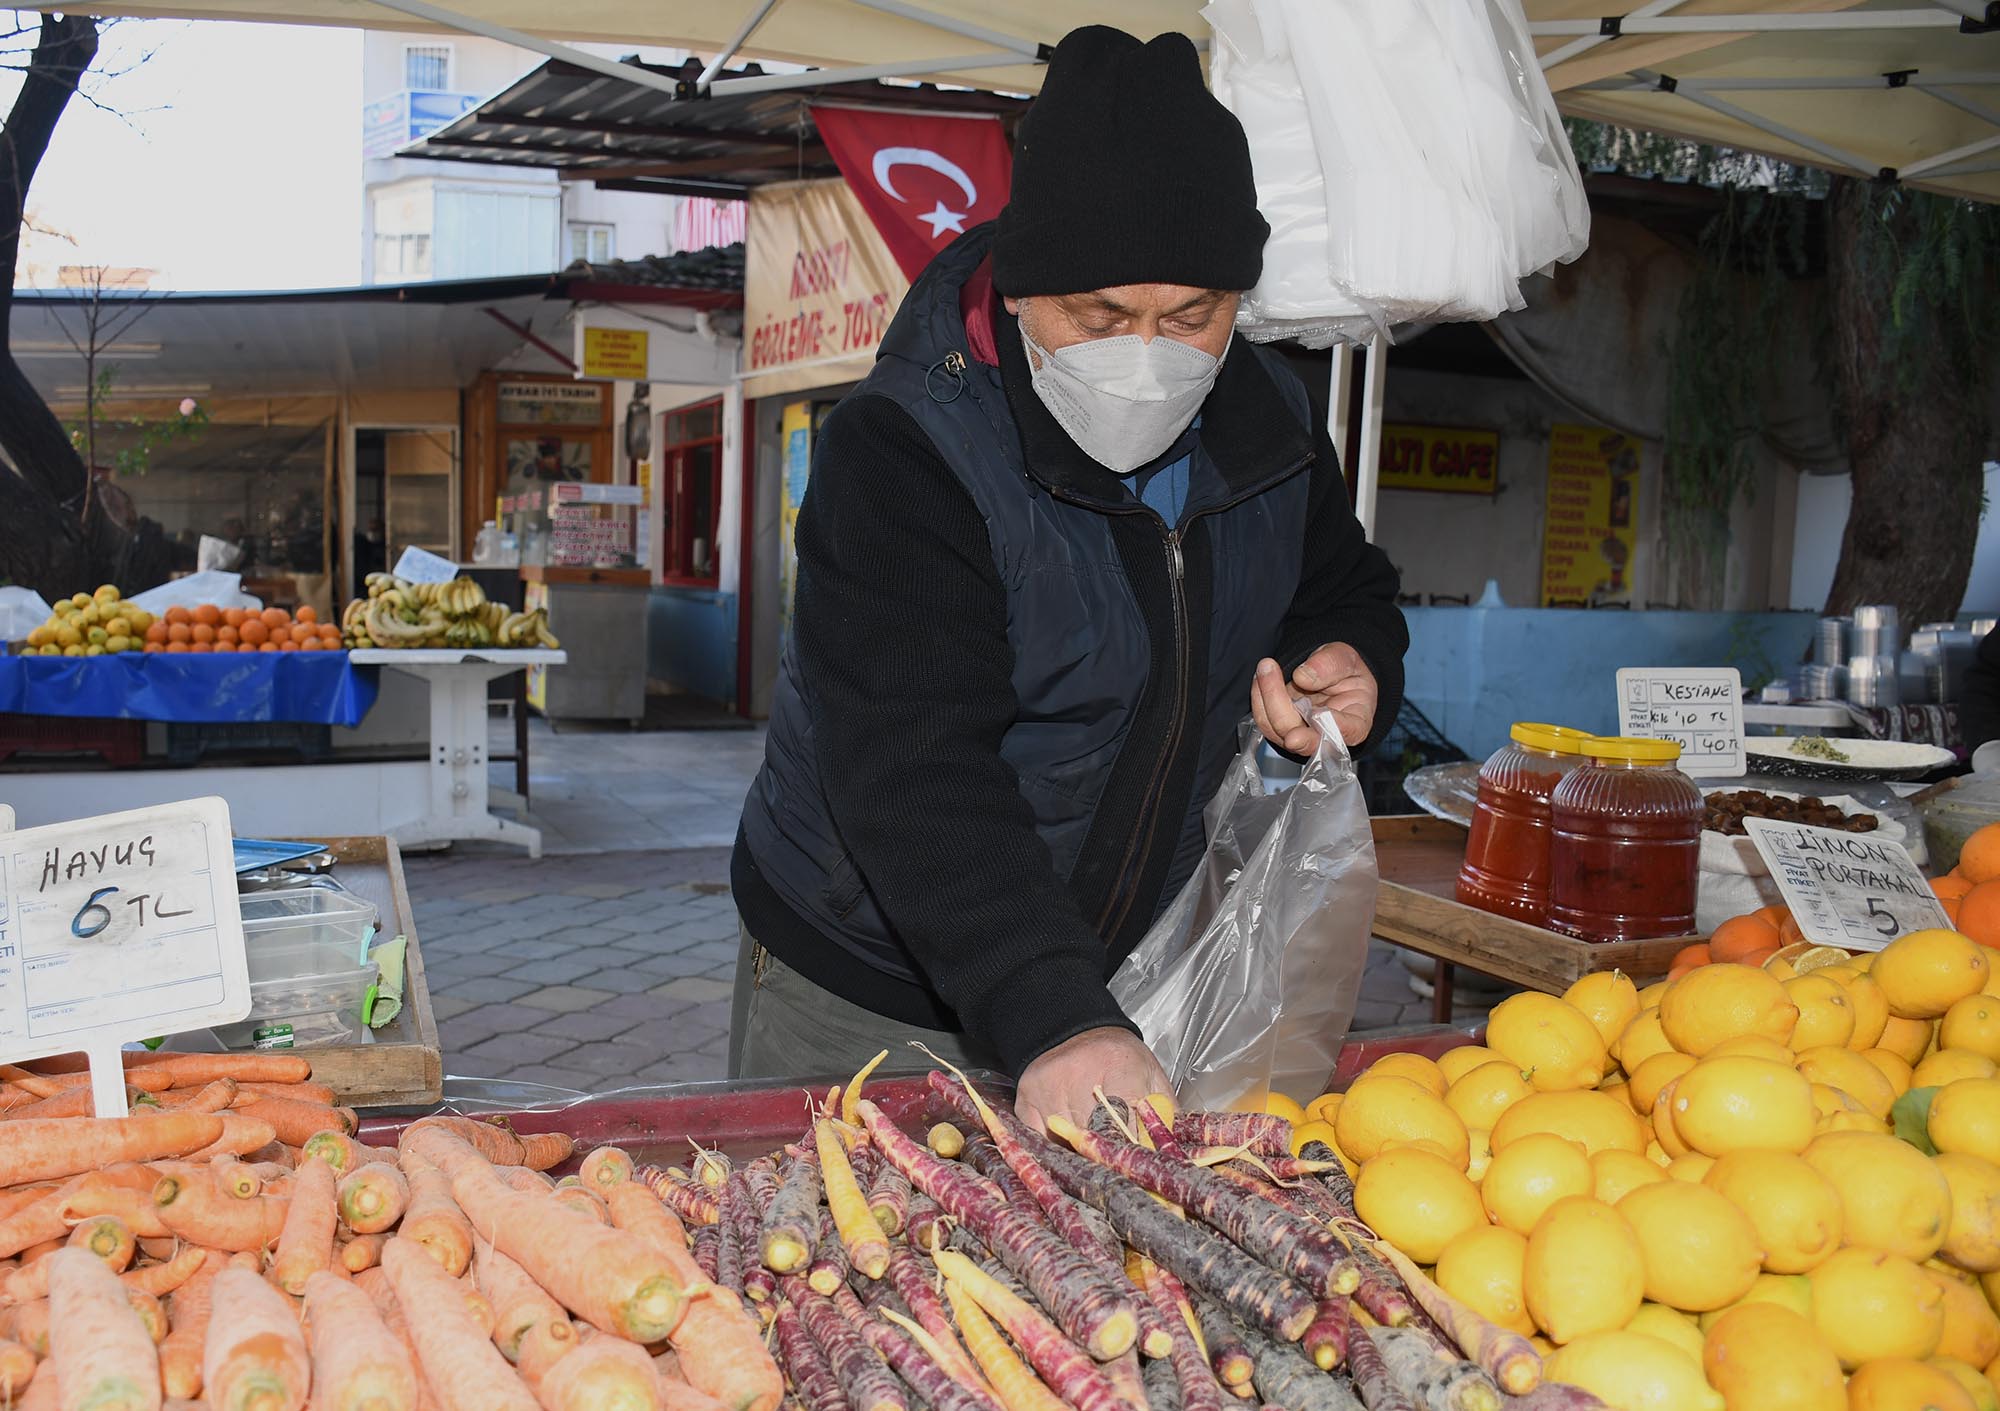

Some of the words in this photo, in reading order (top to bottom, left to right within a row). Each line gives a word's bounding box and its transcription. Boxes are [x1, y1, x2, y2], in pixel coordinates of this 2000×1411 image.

[1430, 440, 1493, 478] CAFE
[1702, 738, 1725, 755] 40
[1795, 828, 1891, 866] LİMON
[1805, 856, 1937, 901] PORTAKAL
[72, 887, 119, 938] 6
[127, 894, 193, 927] TL
[1865, 896, 1900, 937] 5
